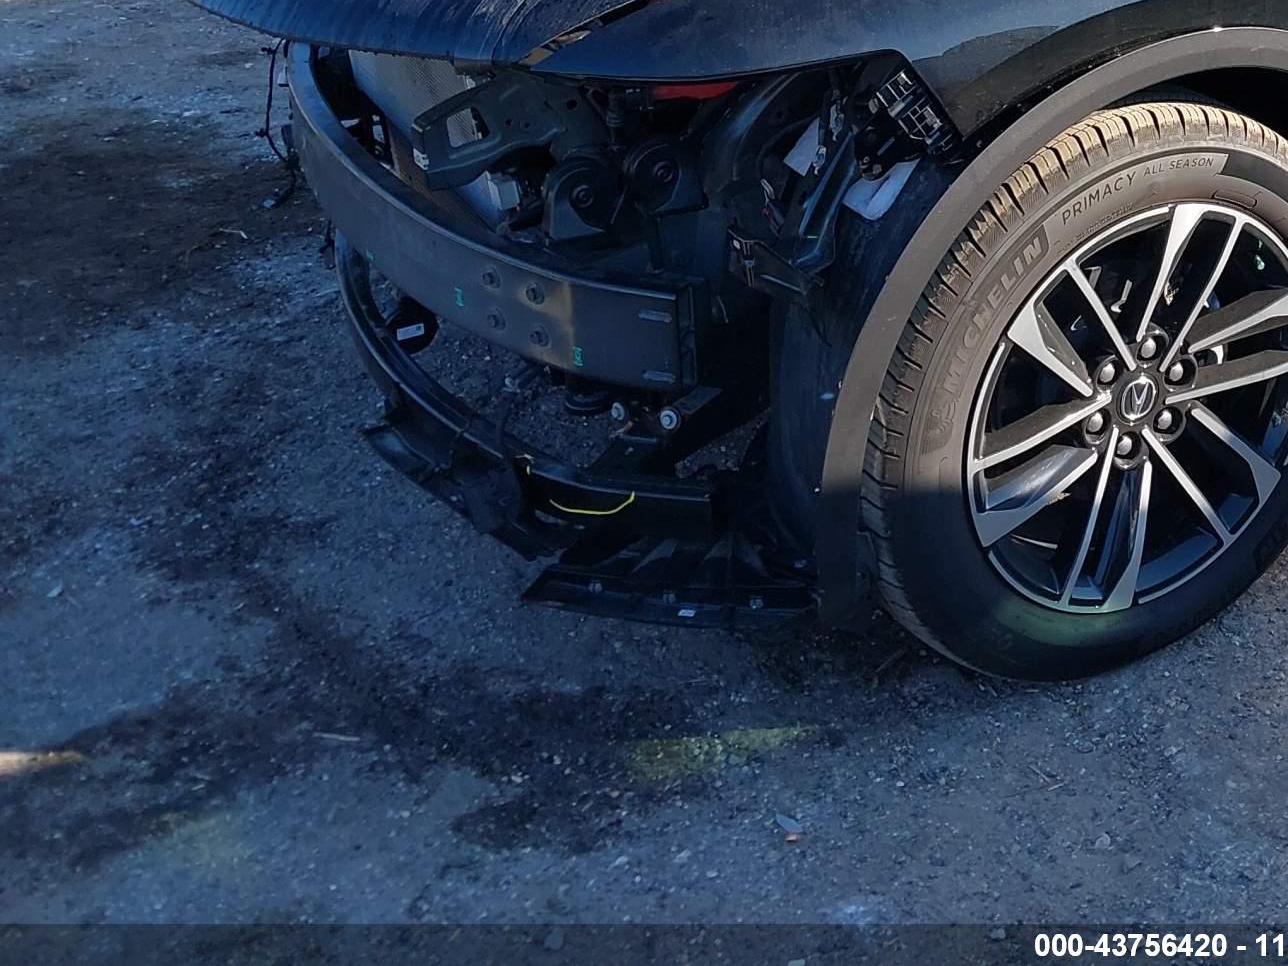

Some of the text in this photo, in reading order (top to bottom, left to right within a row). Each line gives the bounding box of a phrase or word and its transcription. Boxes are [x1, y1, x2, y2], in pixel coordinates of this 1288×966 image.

[1061, 156, 1215, 226] PRIMACY ALL SEASON
[942, 236, 1044, 396] MICHELIN
